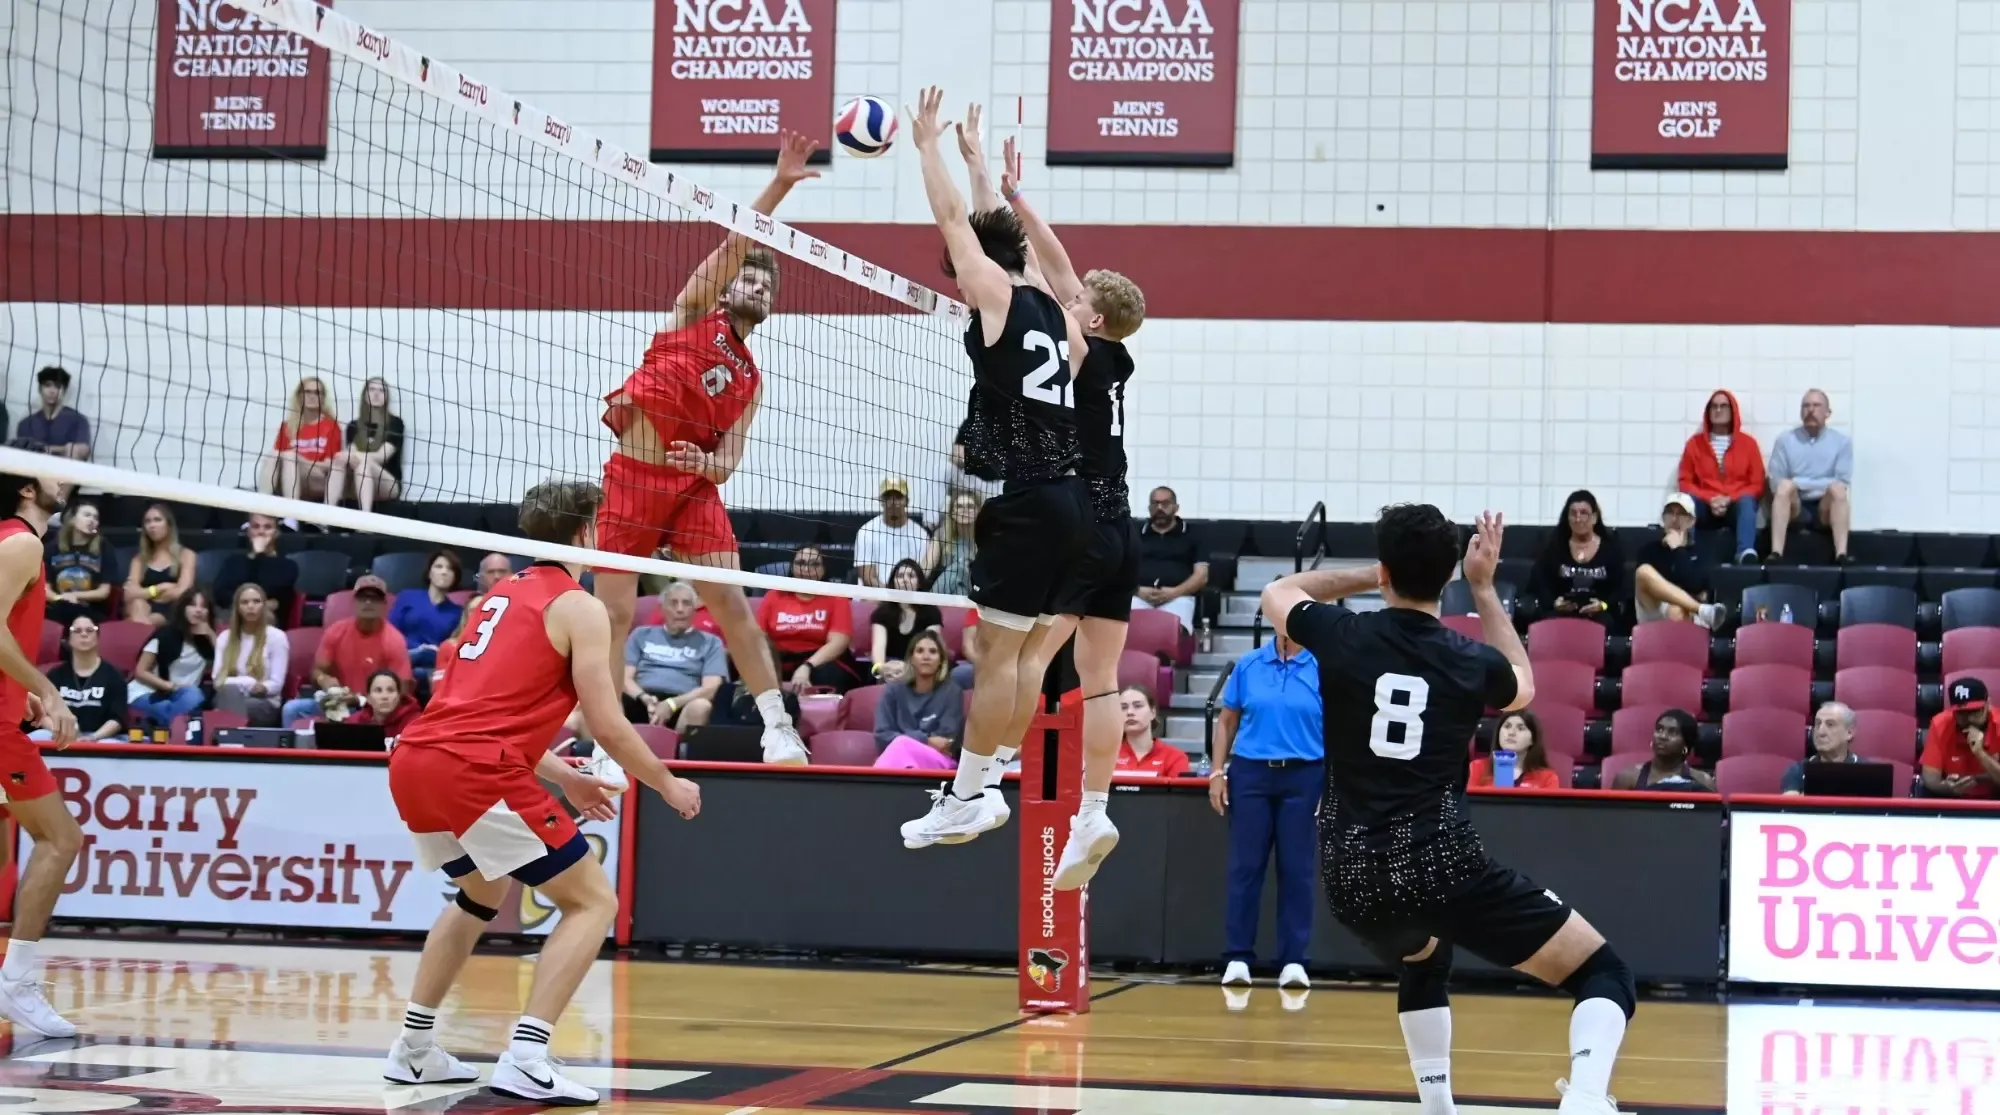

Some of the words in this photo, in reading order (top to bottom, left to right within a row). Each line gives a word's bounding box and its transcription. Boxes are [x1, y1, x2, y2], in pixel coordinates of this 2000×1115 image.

[176, 0, 283, 31] NCA
[672, 0, 812, 33] NCAA
[1070, 0, 1214, 34] NCAA
[1616, 0, 1767, 33] NCAA
[175, 34, 309, 56] NATIONAL
[672, 36, 812, 58] NATIONAL
[1070, 37, 1214, 60] NATIONAL
[1616, 36, 1767, 59] NATIONAL
[173, 57, 308, 77] CHAMPIONS
[671, 60, 812, 80] CHAMPIONS
[1068, 61, 1214, 82] CHAMPIONS
[1615, 61, 1767, 82] CHAMPIONS
[214, 96, 263, 110] MEN'S
[701, 99, 780, 114] WOMEN'S
[1112, 101, 1165, 116] MEN'S
[1663, 101, 1717, 117] MEN'S
[201, 112, 276, 130] TENNIS
[700, 116, 779, 134] TENNIS
[1097, 118, 1179, 137] TENNIS
[1658, 118, 1721, 138] GOLF
[457, 595, 510, 661] 3
[1369, 672, 1429, 760] 8
[51, 767, 257, 849] Barry
[1041, 826, 1056, 875] sports
[1759, 824, 1999, 909] Barry
[1040, 877, 1056, 938] imports
[1758, 895, 2000, 965] Unive
